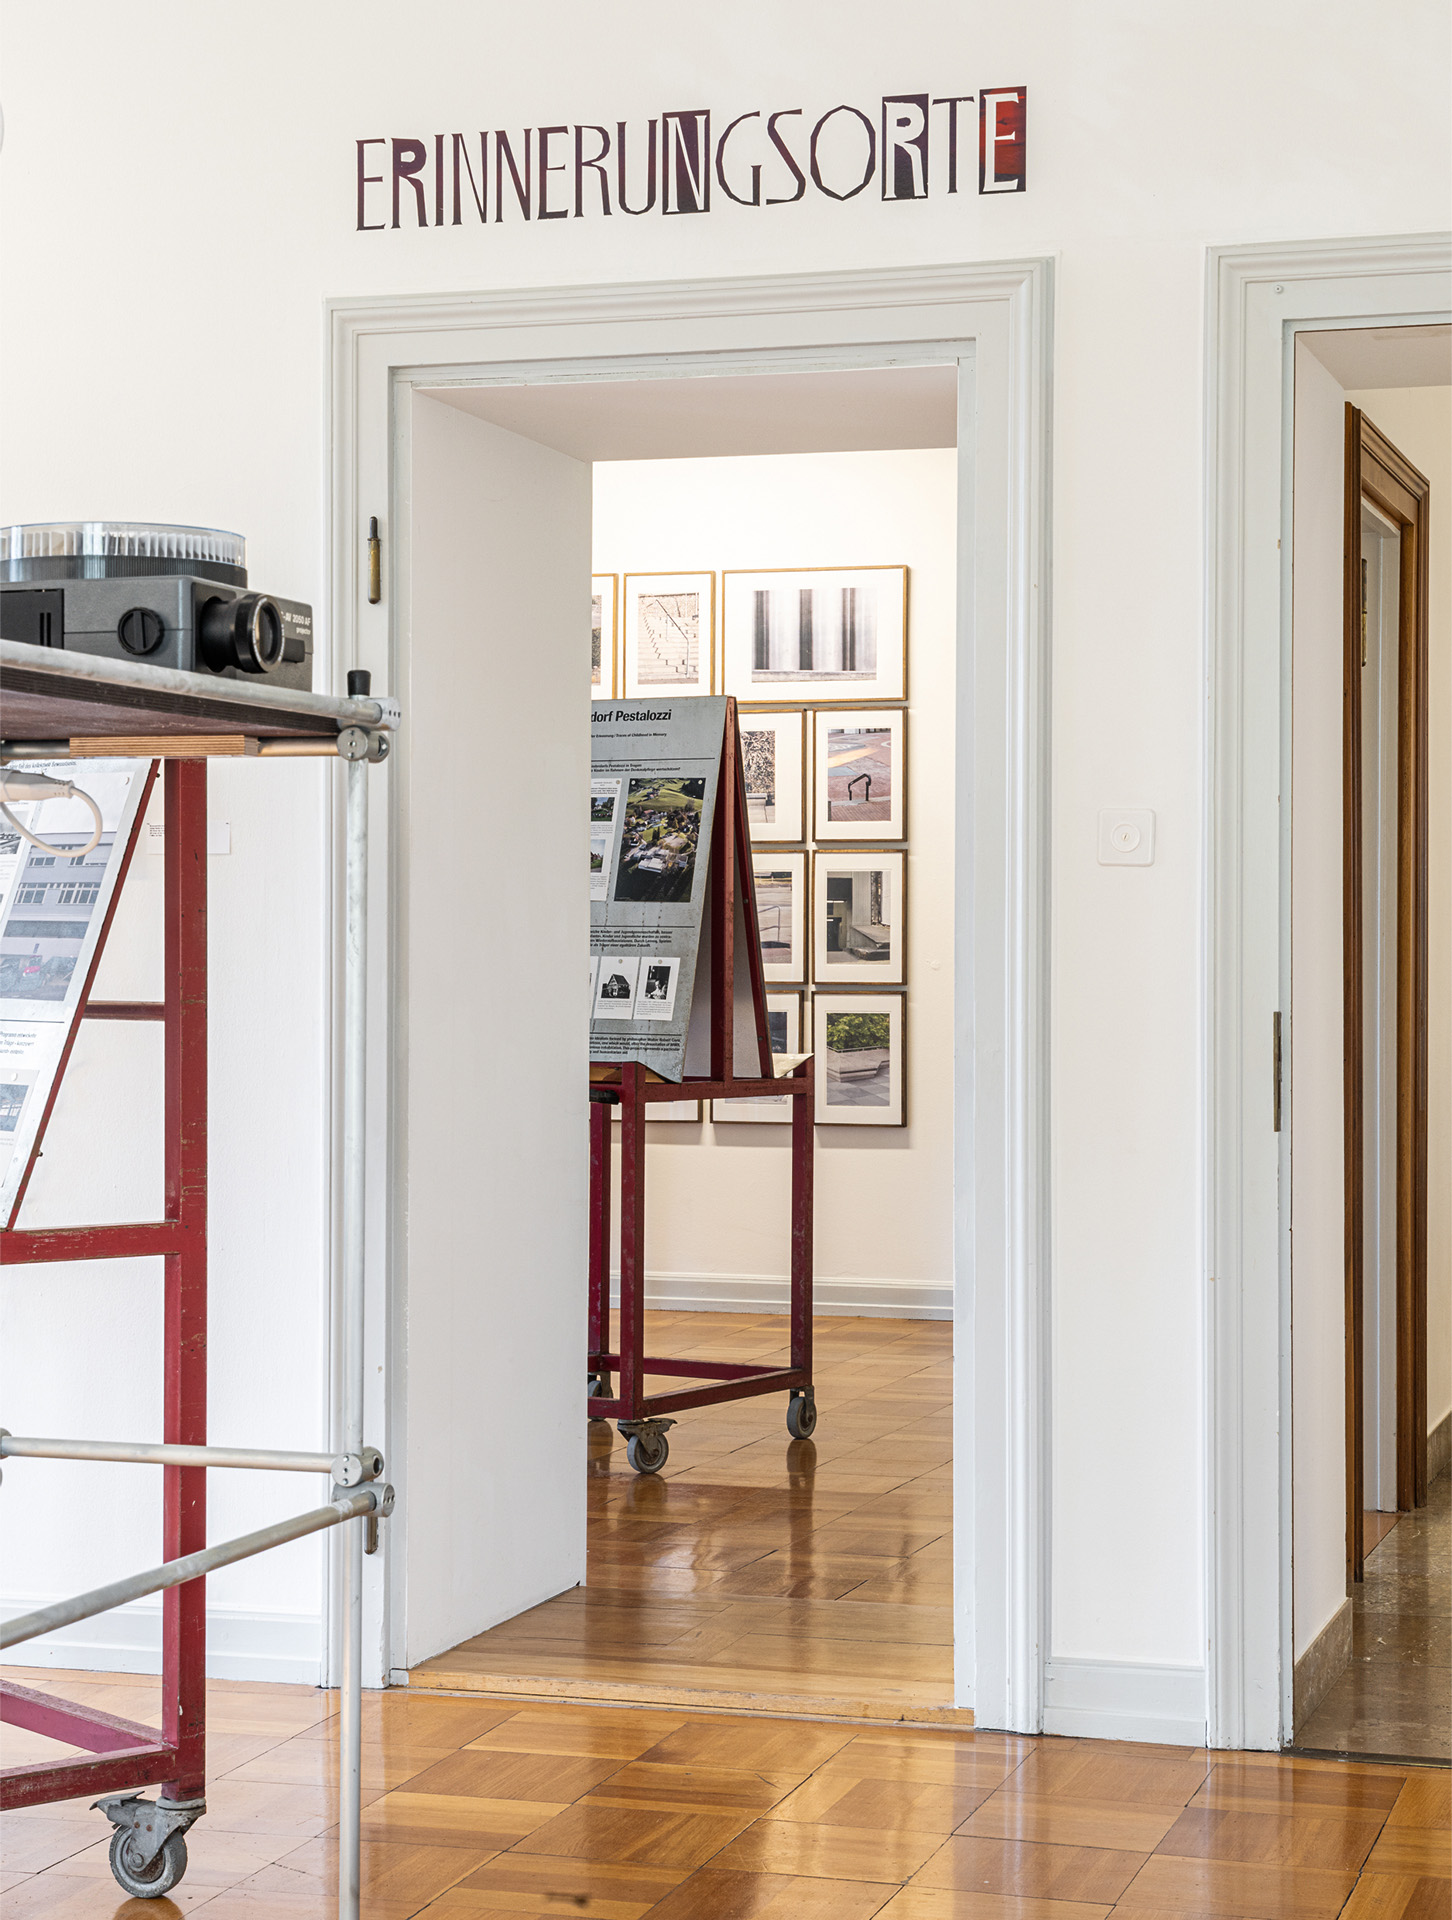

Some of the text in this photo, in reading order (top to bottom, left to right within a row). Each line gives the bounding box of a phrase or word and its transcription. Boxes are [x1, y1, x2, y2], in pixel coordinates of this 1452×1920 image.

[356, 85, 1028, 232] ERINNERUNGSORTE
[293, 614, 304, 624] 2050
[305, 617, 311, 626] AF
[591, 709, 672, 722] dorf Pestalozzi
